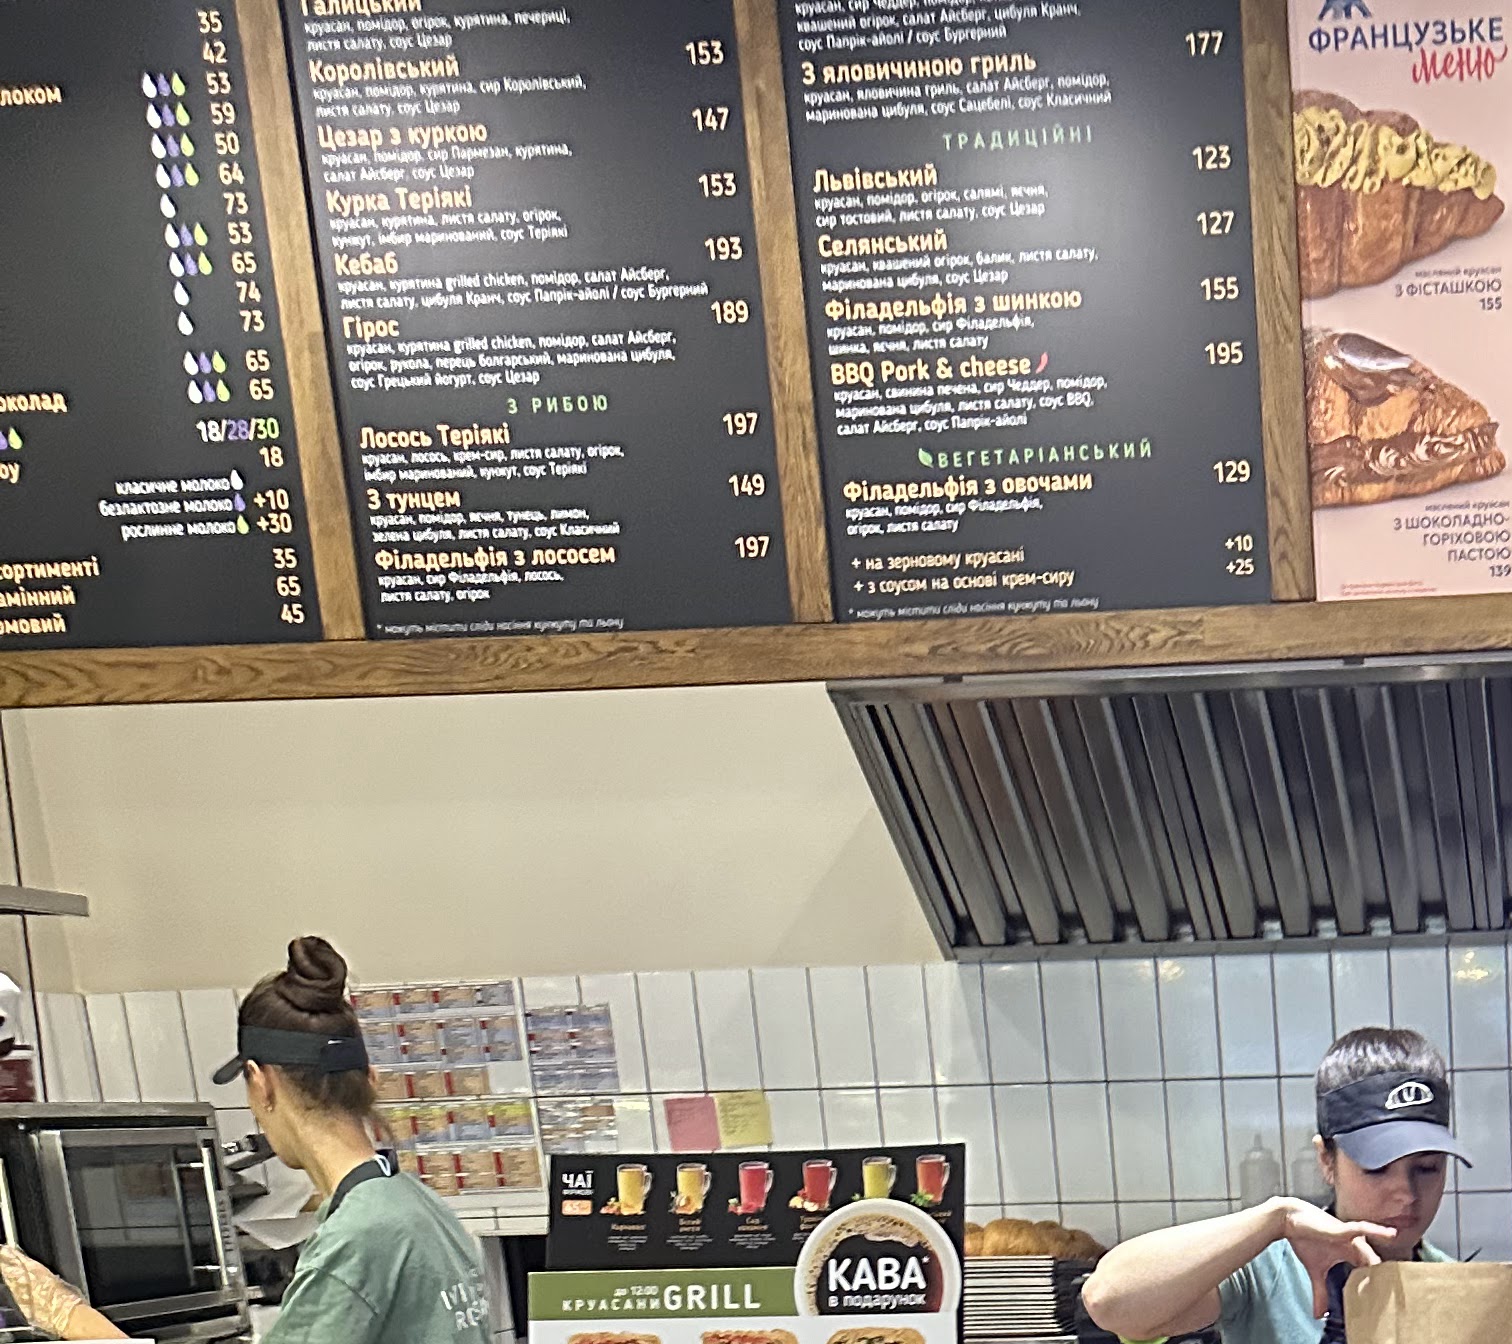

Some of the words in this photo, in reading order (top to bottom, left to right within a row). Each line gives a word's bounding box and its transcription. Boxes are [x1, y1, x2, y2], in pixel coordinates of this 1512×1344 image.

[198, 9, 222, 33] 35
[1308, 17, 1504, 54] ФРАНЦУЗЬКЕ
[203, 42, 227, 64] 42
[309, 54, 459, 86] Королівський
[686, 40, 724, 66] 153
[824, 57, 963, 84] яловичиною
[971, 52, 1037, 79] гриль
[1185, 30, 1223, 56] 177
[206, 72, 230, 94] 53
[966, 80, 1000, 95] салат
[210, 102, 235, 124] 59
[317, 125, 382, 151] Цезар
[407, 124, 488, 148] куркою
[692, 107, 729, 131] 147
[943, 123, 1092, 151] ТРАДИЦІЙНІ
[215, 132, 239, 155] 50
[219, 162, 244, 185] 64
[813, 162, 937, 193] Львівський
[1192, 145, 1231, 171] 123
[224, 193, 248, 214] 73
[326, 190, 390, 216] Курка
[395, 185, 472, 213] Теріякі
[698, 172, 736, 198] 153
[228, 222, 252, 244] 53
[817, 228, 947, 258] Селянський
[1197, 211, 1235, 236] 127
[232, 252, 256, 274] 65
[334, 252, 399, 276] Кебаб
[705, 236, 743, 261] 193
[446, 274, 480, 291] grilled
[483, 271, 528, 288] chicken,
[585, 269, 616, 284] салат
[1405, 278, 1502, 297] ФІСТАШКОЮ
[236, 281, 260, 303] 74
[825, 291, 967, 322] Філадельфія
[993, 290, 1082, 312] шинкою
[1201, 276, 1239, 301] 155
[1479, 297, 1502, 312] 155
[240, 311, 264, 332] 73
[342, 316, 399, 342] Гірос
[711, 300, 749, 324] 189
[245, 350, 270, 371] 65
[830, 361, 875, 387] BBQ
[881, 356, 930, 383] Pork
[936, 358, 953, 379] &
[960, 355, 1031, 379] cheese
[1205, 341, 1244, 365] 195
[249, 378, 274, 400] 65
[532, 395, 608, 414] РИБОЮ
[196, 418, 280, 442] 18/28/30
[360, 427, 432, 449] Лосось
[437, 423, 510, 450] Теріякі
[722, 412, 758, 436] 197
[259, 447, 284, 467] 18
[937, 438, 1152, 468] ВЕГЕТАРІАНСЬКИЙ
[115, 480, 178, 496] класичне
[181, 477, 230, 493] молоко
[386, 491, 461, 513] тунцем
[728, 473, 765, 497] 149
[843, 475, 978, 503] Філадельфія
[1002, 473, 1093, 494] овочами
[1213, 460, 1251, 484] 129
[98, 500, 180, 517] безлактозне
[183, 498, 233, 514] молоко
[253, 489, 289, 510] +10
[121, 522, 184, 541] рослинне
[187, 519, 236, 536] молоко
[256, 513, 292, 533] +30
[1405, 513, 1511, 530] ШОКОЛАДНО-
[1422, 530, 1511, 546] ГОРІХОВОЮ
[273, 548, 298, 569] 35
[375, 547, 508, 572] Філадельфія
[531, 546, 615, 566] лососем
[734, 535, 770, 559] 197
[865, 557, 883, 571] на
[887, 551, 960, 572] зерновому
[965, 546, 1025, 569] круасані
[1224, 534, 1253, 552] +10
[1447, 546, 1511, 563] ПАСТОЮ
[276, 576, 301, 597] 65
[879, 577, 927, 596] соусом
[931, 574, 950, 590] на
[953, 570, 997, 590] основі
[1002, 568, 1075, 591] крем-сиру
[1225, 558, 1255, 576] +25
[280, 604, 305, 625] 45
[561, 1170, 595, 1189] ЧАЇ
[562, 1297, 661, 1312] КРУАСАНИ
[663, 1284, 761, 1311] GRILL
[843, 1293, 926, 1309] подарунок
